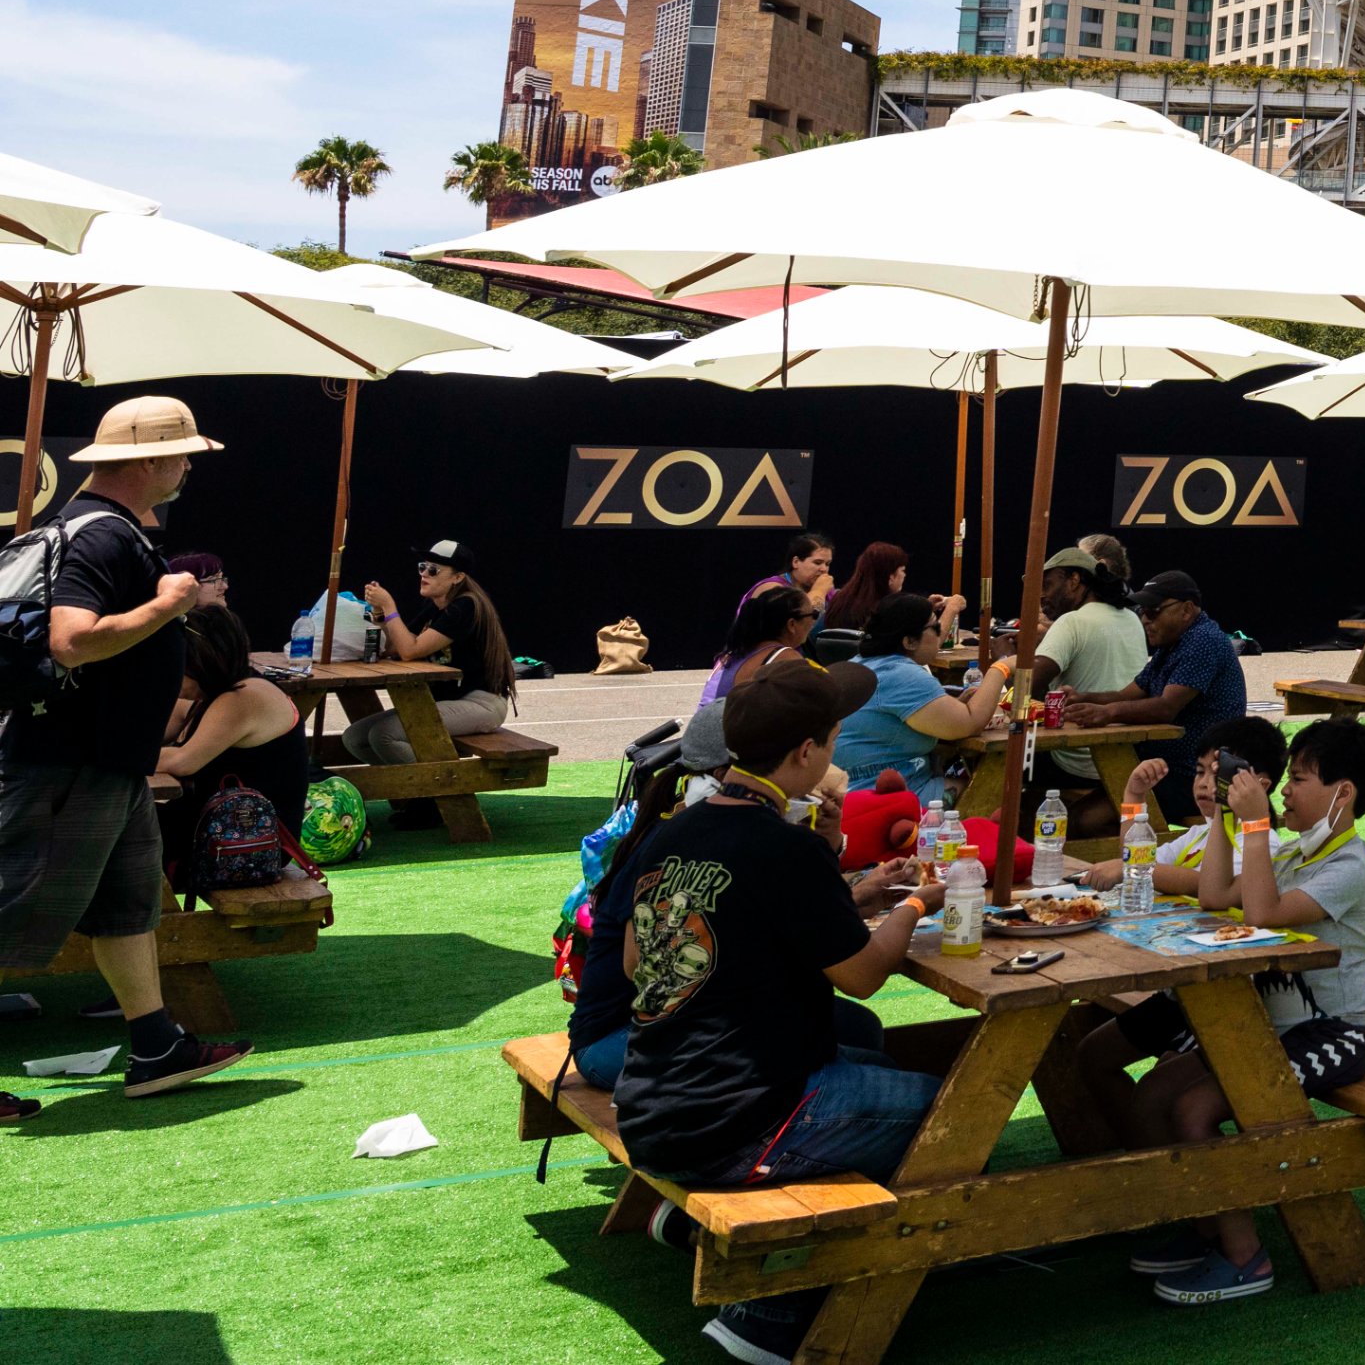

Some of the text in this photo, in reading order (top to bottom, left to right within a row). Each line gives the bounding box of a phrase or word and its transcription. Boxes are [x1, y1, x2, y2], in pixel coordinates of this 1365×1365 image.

[531, 167, 583, 180] SEASON
[552, 179, 581, 191] FALL
[572, 447, 803, 526] ZOA
[1119, 456, 1299, 526] ZOA
[648, 856, 733, 913] POWER
[1178, 1290, 1222, 1303] crocs
